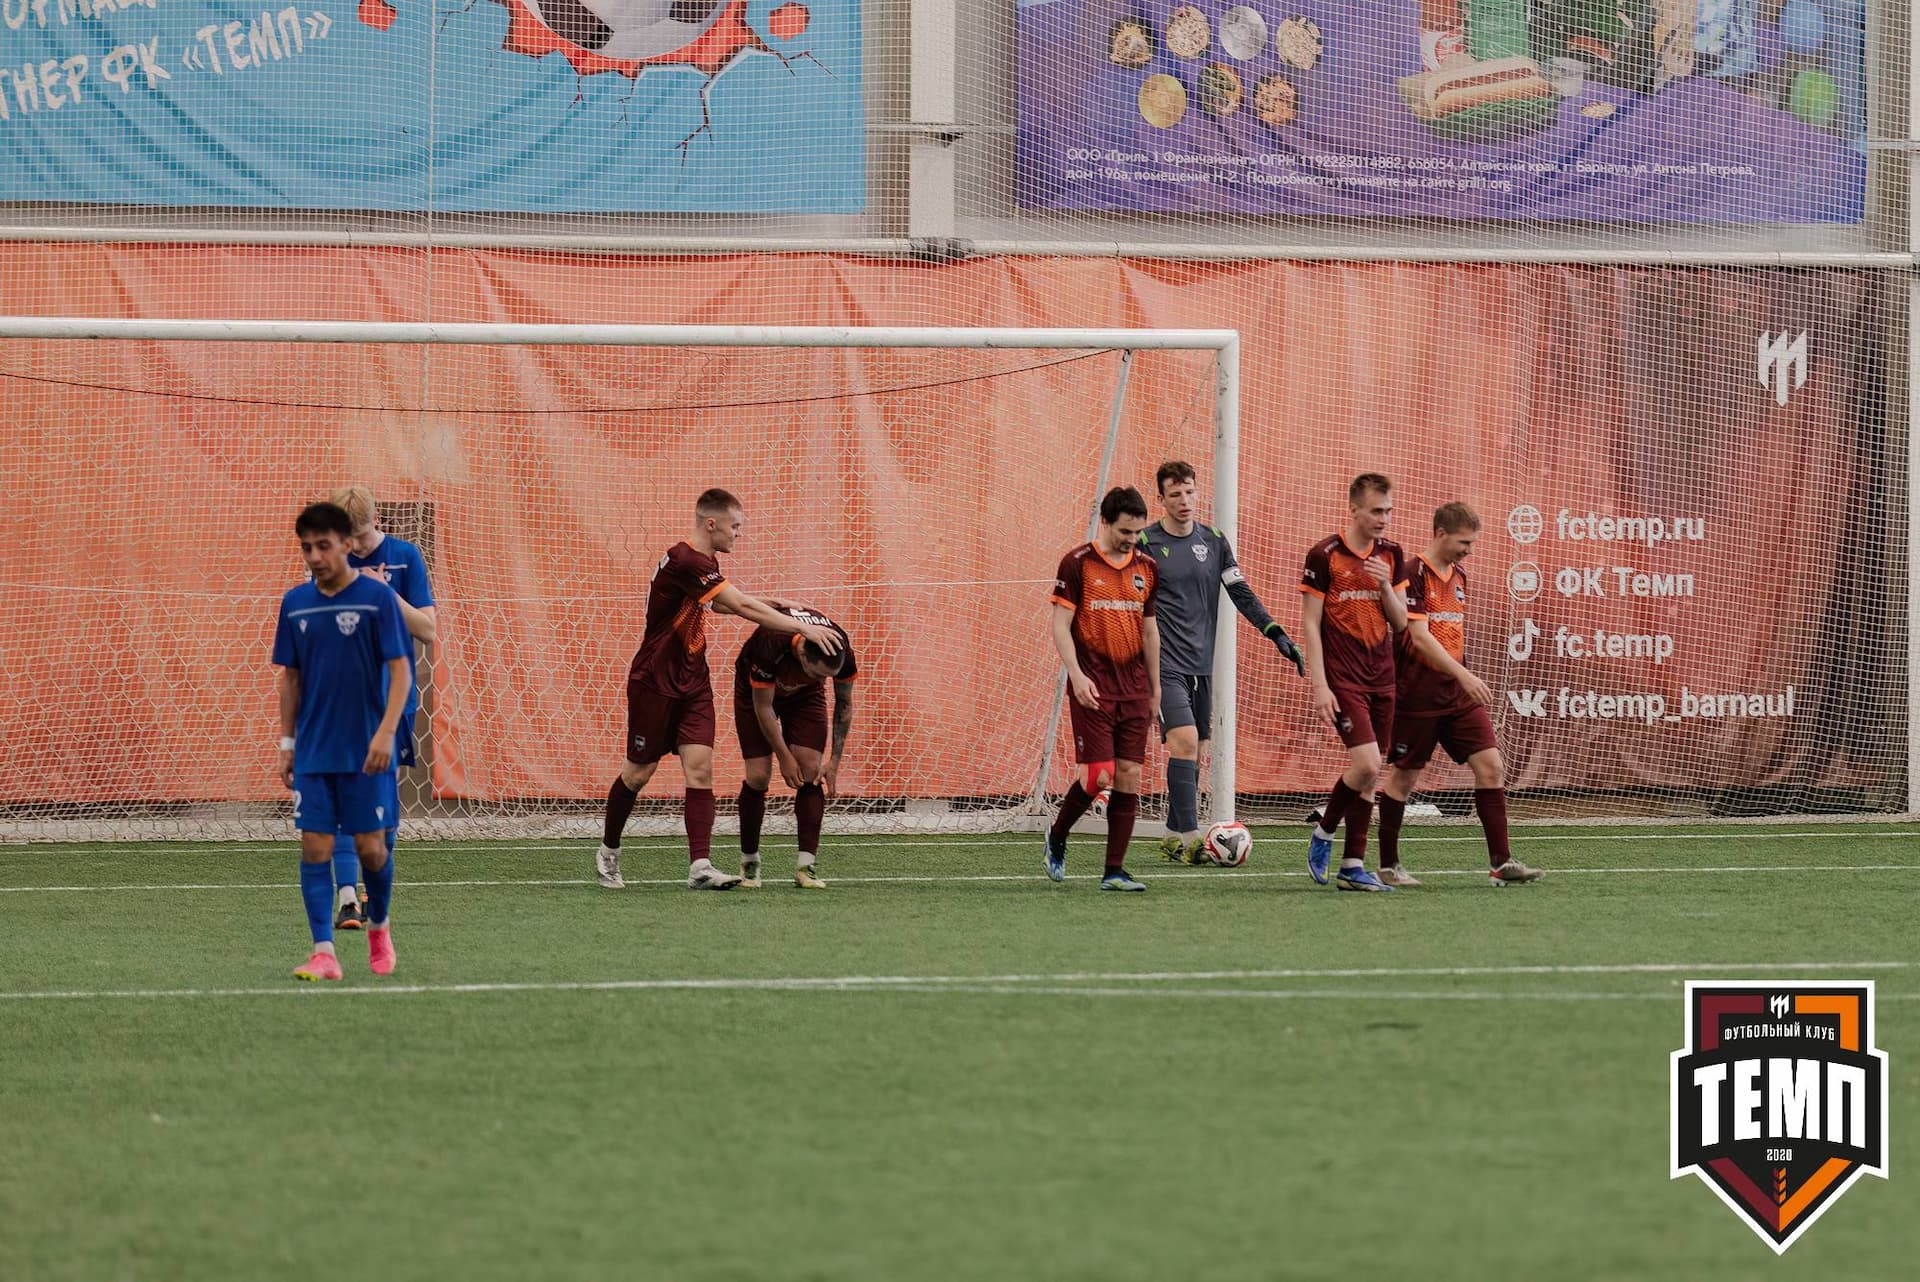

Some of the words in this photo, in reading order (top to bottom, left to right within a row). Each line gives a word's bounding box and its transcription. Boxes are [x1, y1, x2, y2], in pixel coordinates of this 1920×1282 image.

[102, 36, 171, 94] ФК
[183, 6, 333, 76] «ТЕМП»
[1066, 169, 1093, 180] дом
[1134, 171, 1210, 183] помещение
[1067, 148, 1100, 161] ООО
[1260, 153, 1296, 167] ОГРН
[1654, 163, 1697, 175] Антона
[1556, 508, 1705, 548] fctemp.ru
[1555, 566, 1605, 598] ФК
[1612, 567, 1695, 597] Темп
[1555, 627, 1674, 665] fc.temp
[1556, 685, 1794, 727] fctemp_barnaul
